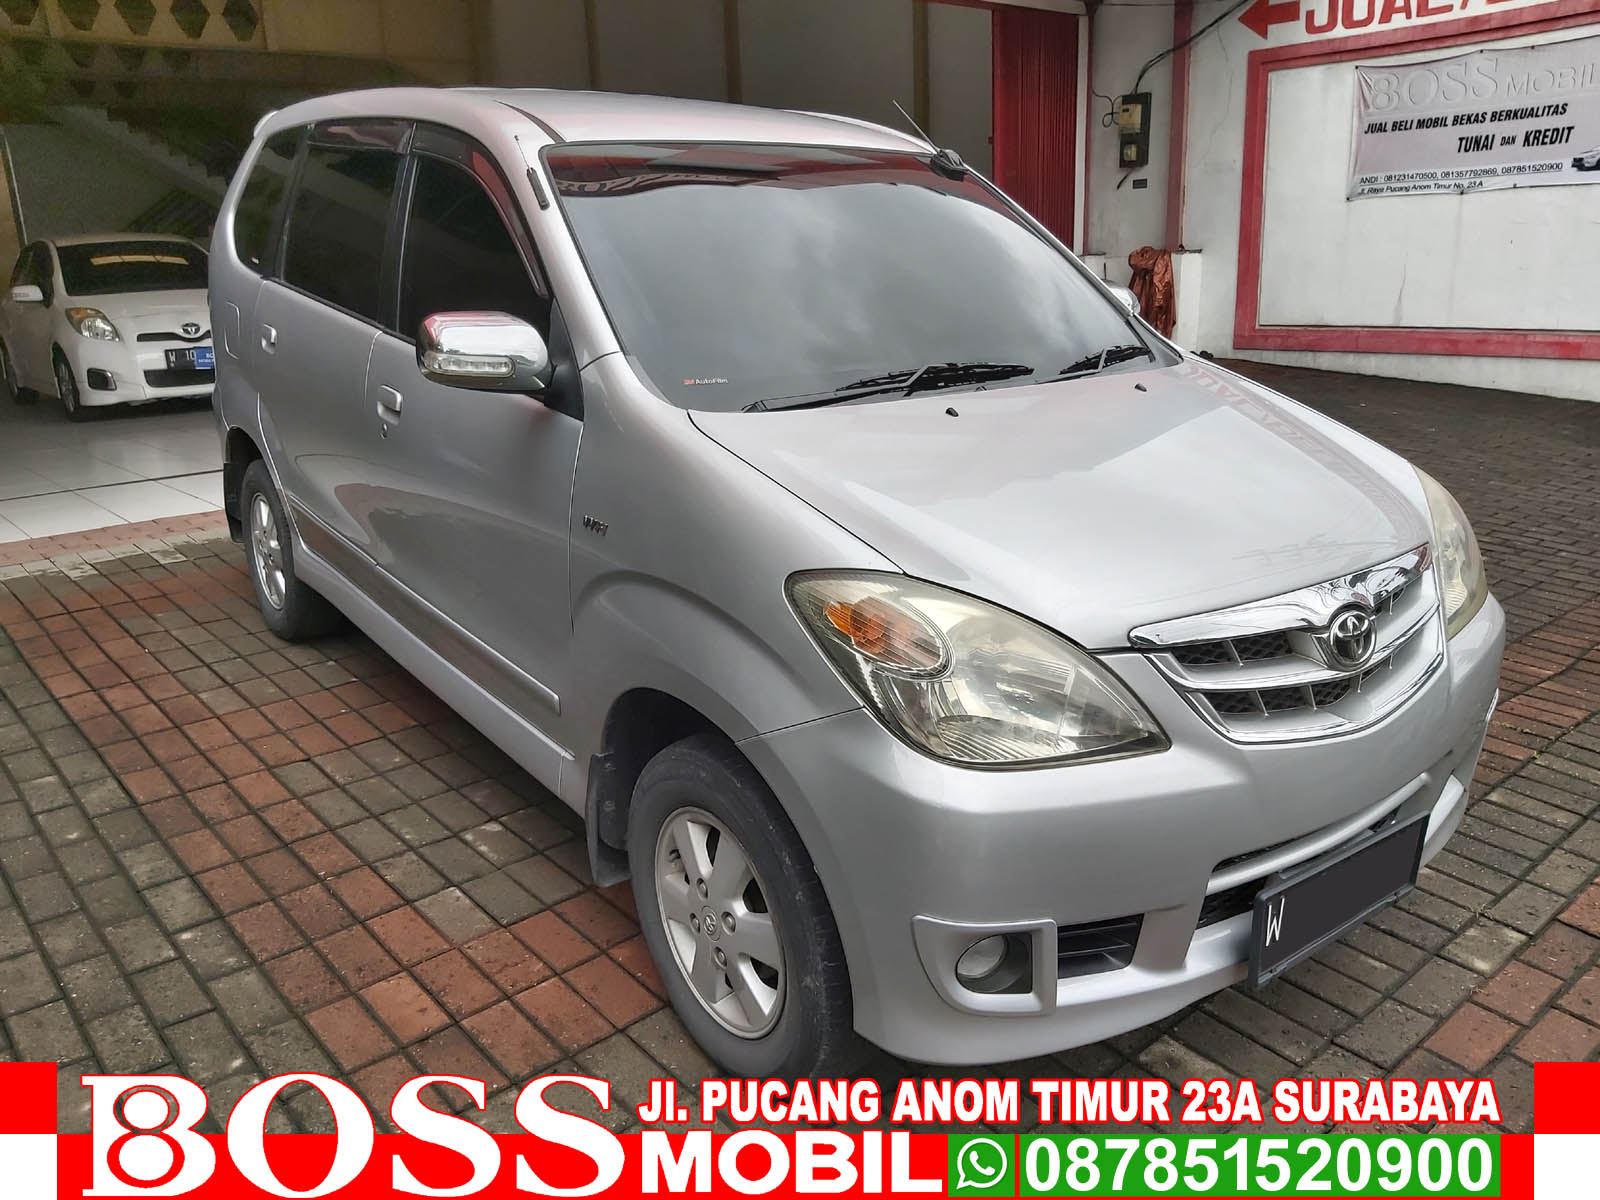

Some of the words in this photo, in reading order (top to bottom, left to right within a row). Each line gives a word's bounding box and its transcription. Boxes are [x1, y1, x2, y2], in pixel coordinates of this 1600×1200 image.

[1365, 121, 1388, 134] JUAL
[1391, 119, 1413, 132] BELI
[1415, 116, 1449, 129] MOBIL
[1452, 111, 1487, 127] BEKAS
[1489, 102, 1568, 122] BERKUALITAS
[1457, 133, 1495, 153] TUNAI
[1500, 135, 1516, 146] DAN
[1522, 126, 1575, 148] KREDIT
[1360, 175, 1378, 185] ANDI
[1385, 184, 1410, 194] Pucang
[1411, 183, 1432, 192] Anom
[1433, 182, 1453, 190] Timur
[1264, 896, 1286, 947] W
